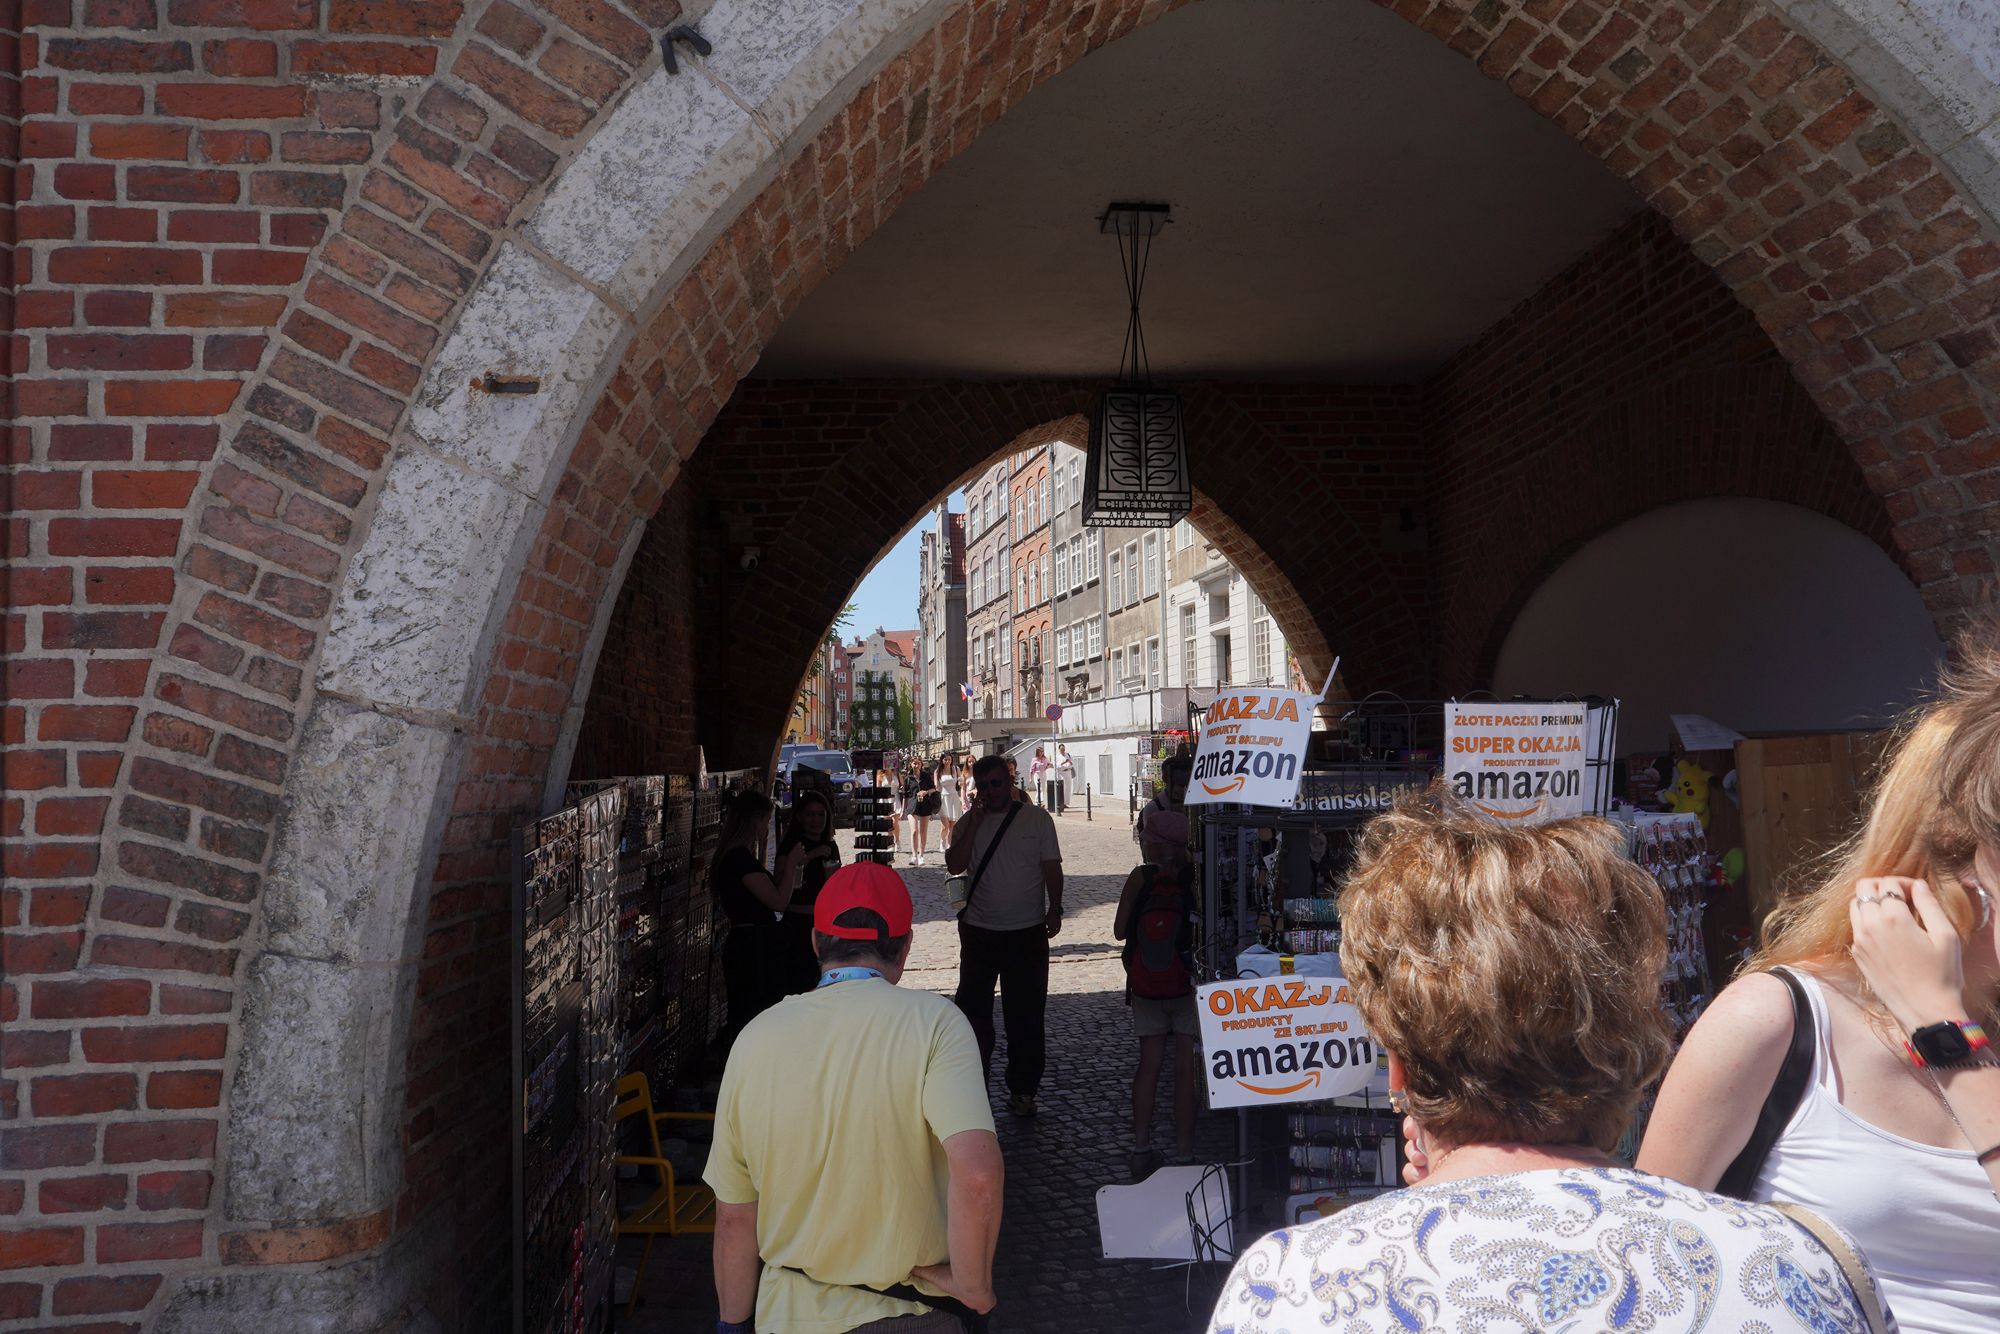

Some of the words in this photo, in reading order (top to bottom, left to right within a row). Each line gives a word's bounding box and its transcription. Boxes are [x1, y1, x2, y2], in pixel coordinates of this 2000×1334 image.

[1105, 501, 1184, 509] CHLEBNICKA
[1205, 696, 1299, 725] OKAZJA
[1454, 715, 1493, 727] ZŁOTE
[1495, 715, 1538, 726] PACZKI
[1541, 715, 1583, 726] PREMIUM
[1207, 724, 1242, 738] PRODUKTY
[1225, 735, 1238, 745] ZE
[1238, 735, 1284, 746] SKLEPU
[1452, 736, 1515, 753] SUPER
[1518, 736, 1581, 753] OKAZJA
[1193, 750, 1297, 781] amazon
[1483, 759, 1527, 767] PRODUKTY
[1527, 759, 1537, 767] ZE
[1452, 768, 1580, 800] amazon
[1208, 982, 1353, 1017] OKAZJA
[1221, 1014, 1294, 1032] PRODUKTY
[1273, 1025, 1293, 1039] ZE
[1294, 1021, 1348, 1037] SKLEPU
[1211, 1035, 1373, 1080] amazon
